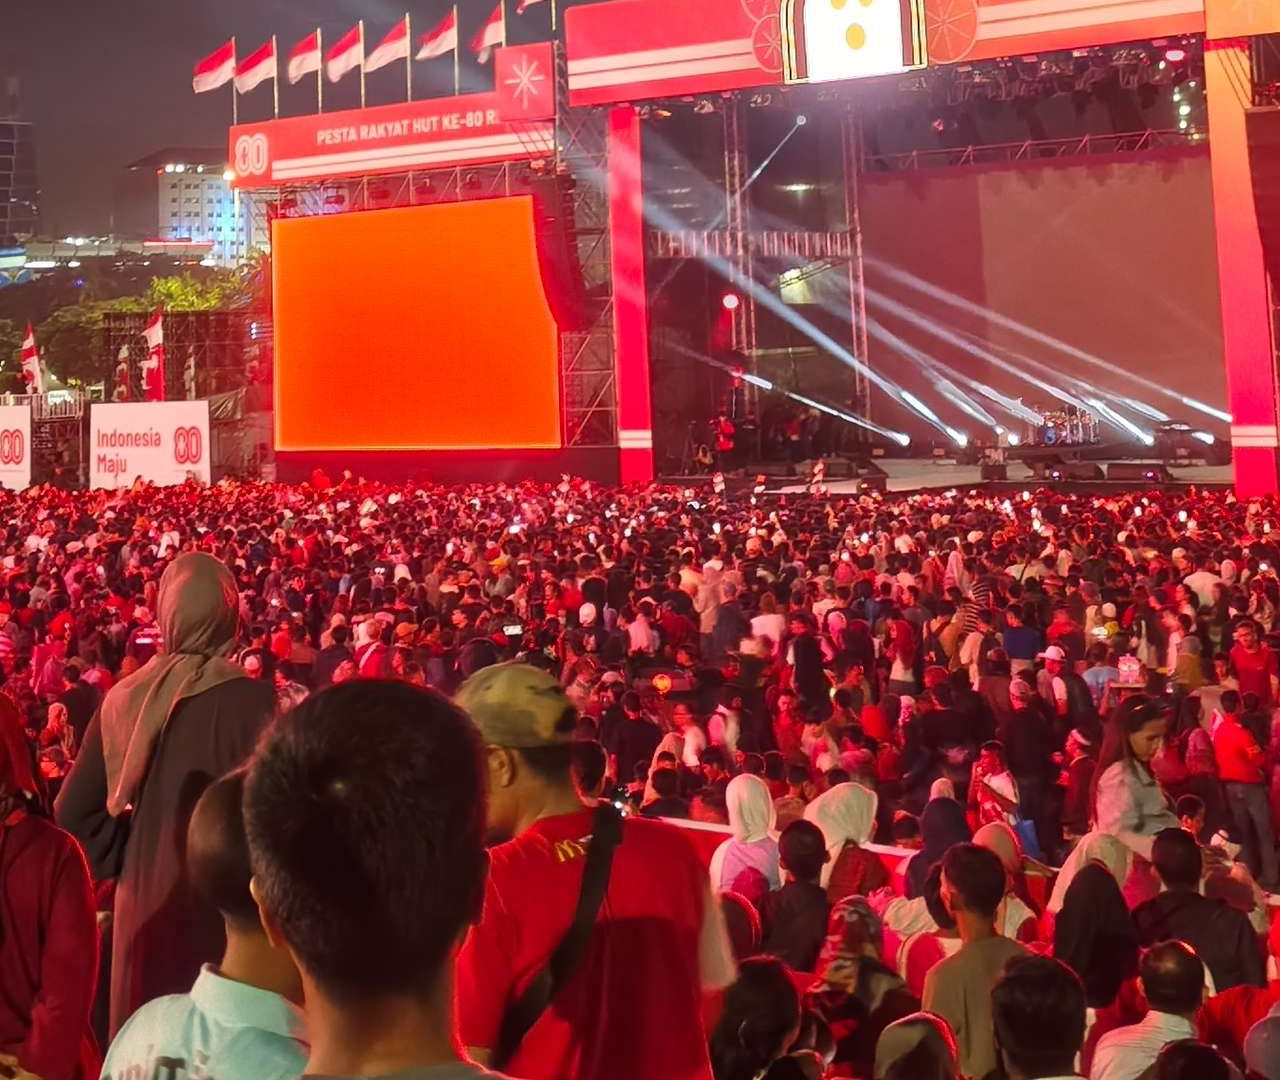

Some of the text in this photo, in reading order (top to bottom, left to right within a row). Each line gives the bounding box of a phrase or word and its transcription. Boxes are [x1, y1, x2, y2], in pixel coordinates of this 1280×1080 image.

[316, 127, 358, 145] PESTA
[359, 120, 409, 140] RAKYAT
[412, 116, 439, 134] HUT
[441, 111, 484, 131] KE-80
[235, 133, 268, 177] 80
[97, 427, 162, 448] Indonesia
[96, 453, 127, 480] Maju
